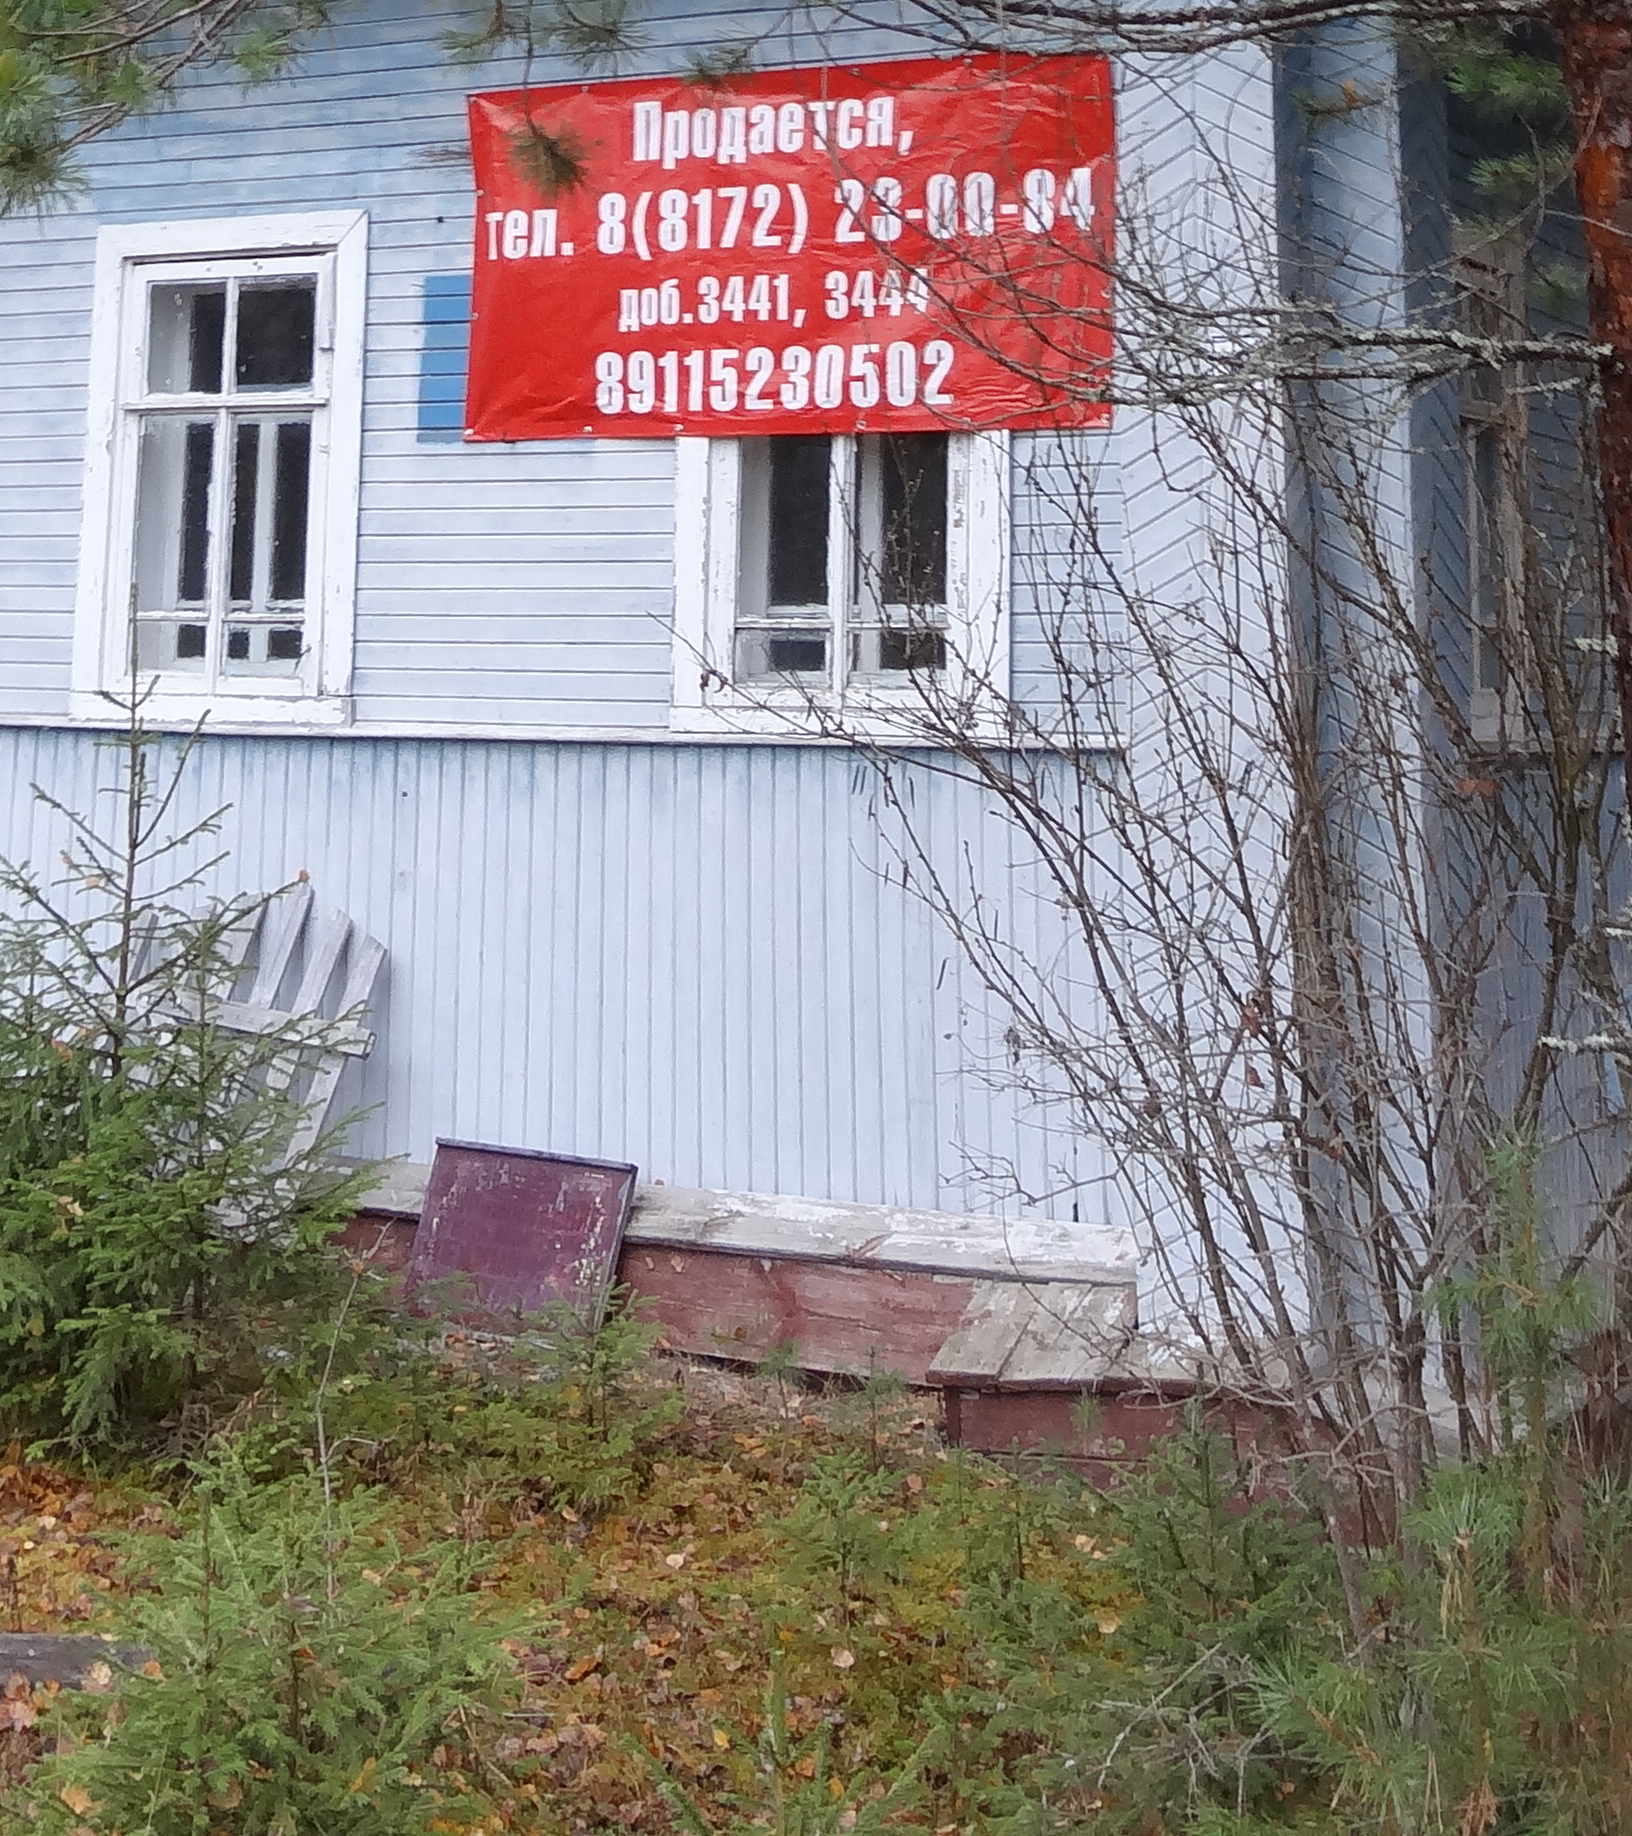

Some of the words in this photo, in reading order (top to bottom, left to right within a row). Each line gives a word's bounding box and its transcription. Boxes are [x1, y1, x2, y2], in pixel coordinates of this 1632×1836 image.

[632, 96, 914, 170] Продается,
[485, 208, 575, 261] тел.
[596, 182, 808, 261] 8(8172)
[833, 167, 1097, 243] 23-00-84
[618, 273, 807, 332] доб.3441,
[824, 268, 930, 320] 3444
[595, 339, 955, 414] 89115230502
